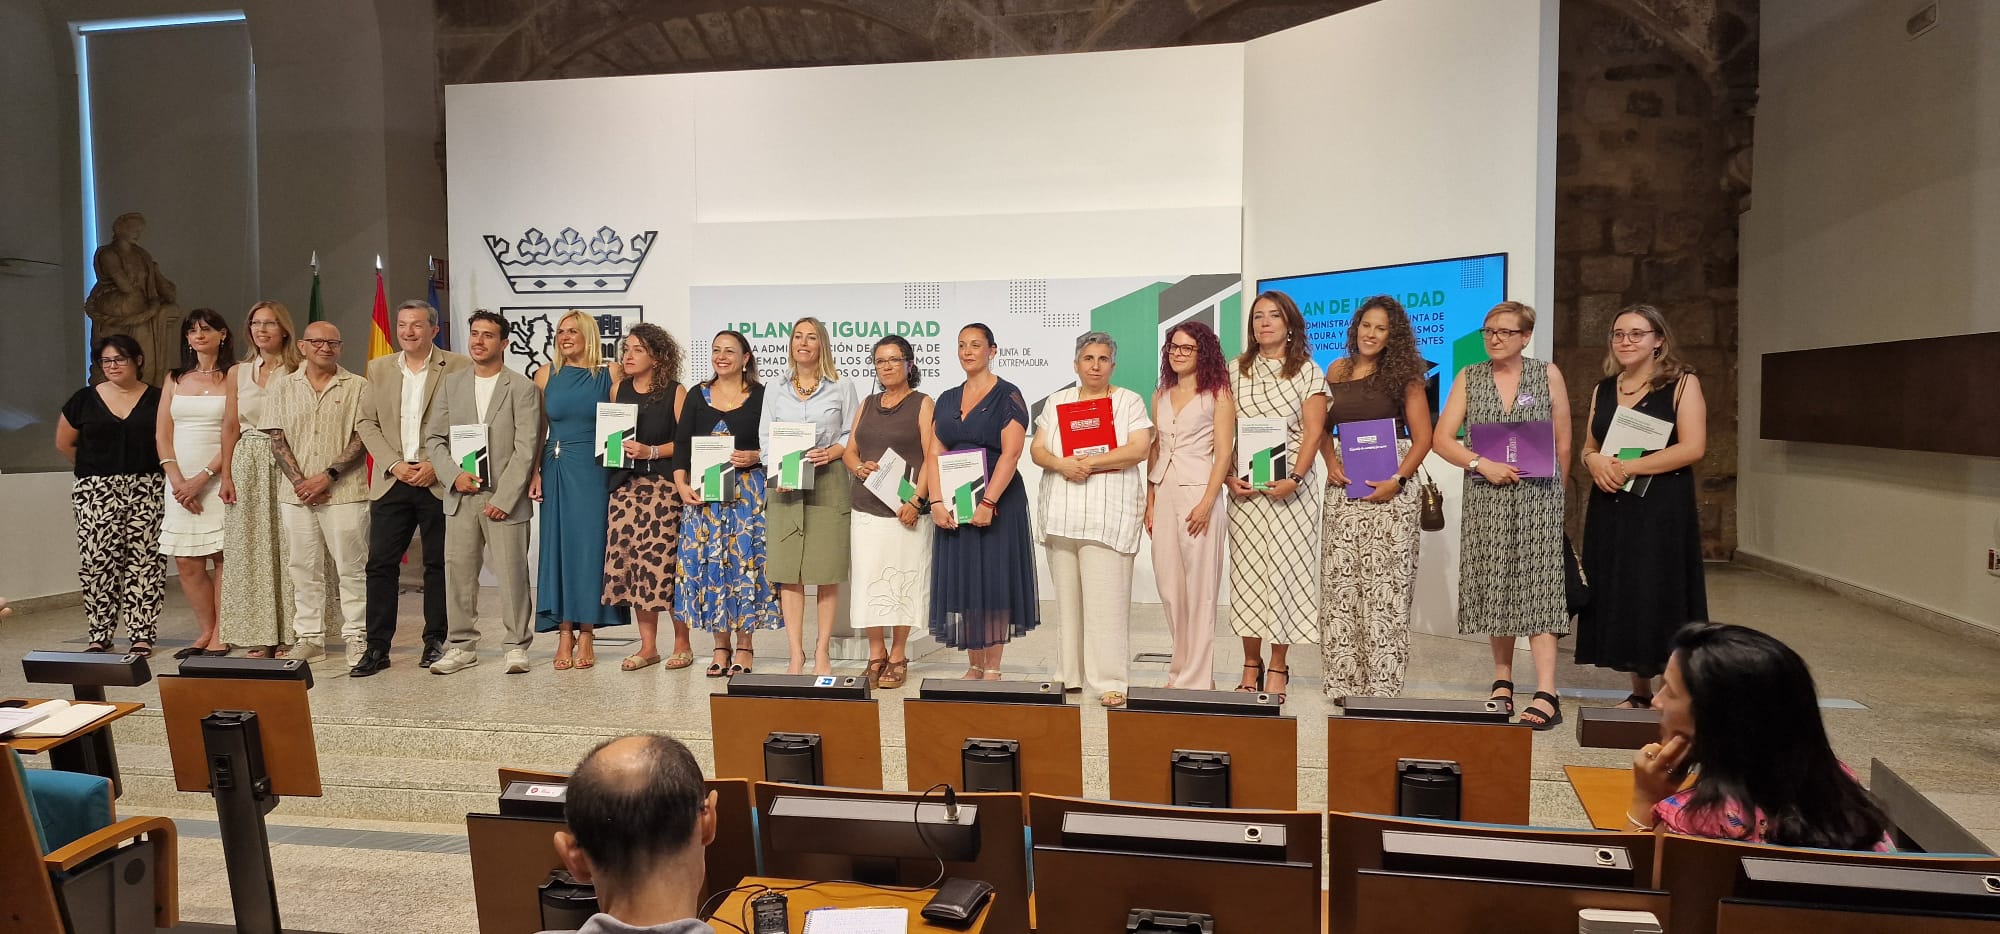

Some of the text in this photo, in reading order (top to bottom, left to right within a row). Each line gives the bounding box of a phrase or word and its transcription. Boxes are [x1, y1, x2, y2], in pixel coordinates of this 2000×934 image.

[1329, 298, 1350, 314] DE
[1432, 312, 1445, 321] DE
[740, 322, 792, 338] PLAN
[832, 320, 940, 338] IGUALDAD
[1338, 330, 1344, 338] Y
[857, 344, 870, 353] DE
[926, 344, 940, 352] DE
[999, 347, 1032, 356] JUNTA DE
[840, 356, 860, 365] LOS
[998, 358, 1049, 367] EXTREMADURA
[851, 368, 860, 377] O
